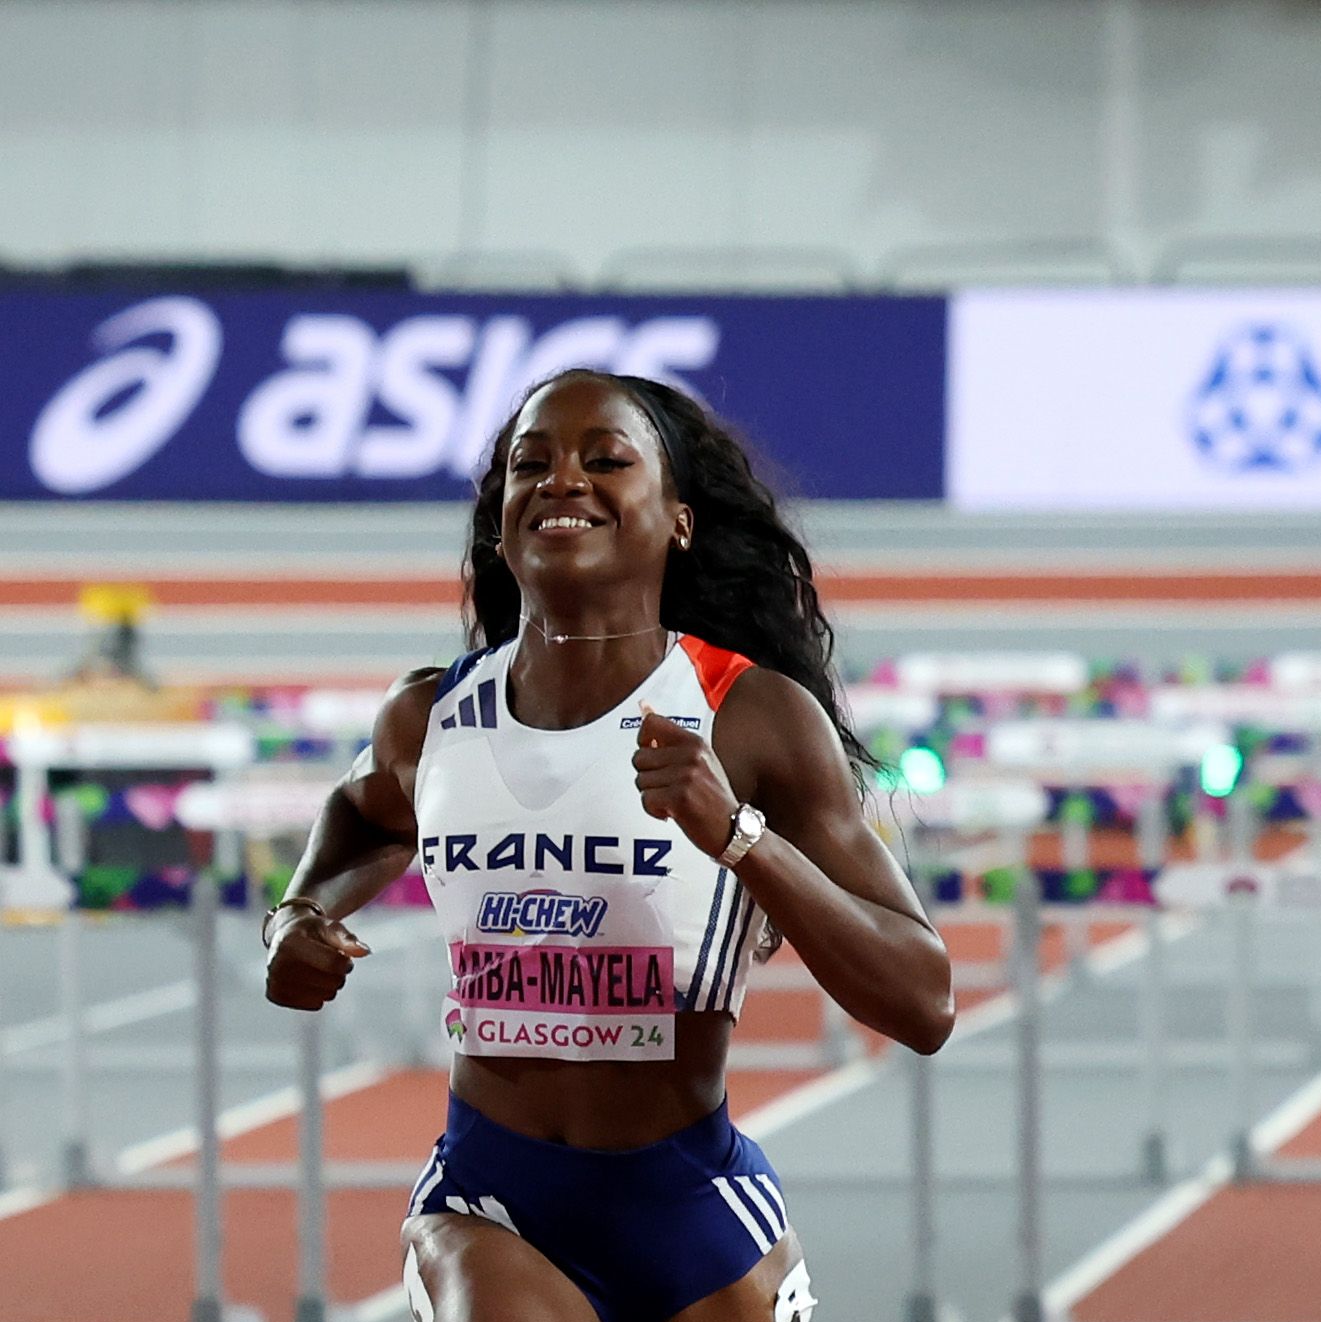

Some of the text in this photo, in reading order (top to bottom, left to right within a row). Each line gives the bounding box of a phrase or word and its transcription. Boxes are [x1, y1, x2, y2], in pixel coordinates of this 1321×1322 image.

[421, 833, 673, 877] FRANCE
[477, 891, 608, 937] HI-CHEW
[477, 1019, 665, 1048] GLASGOW 24
